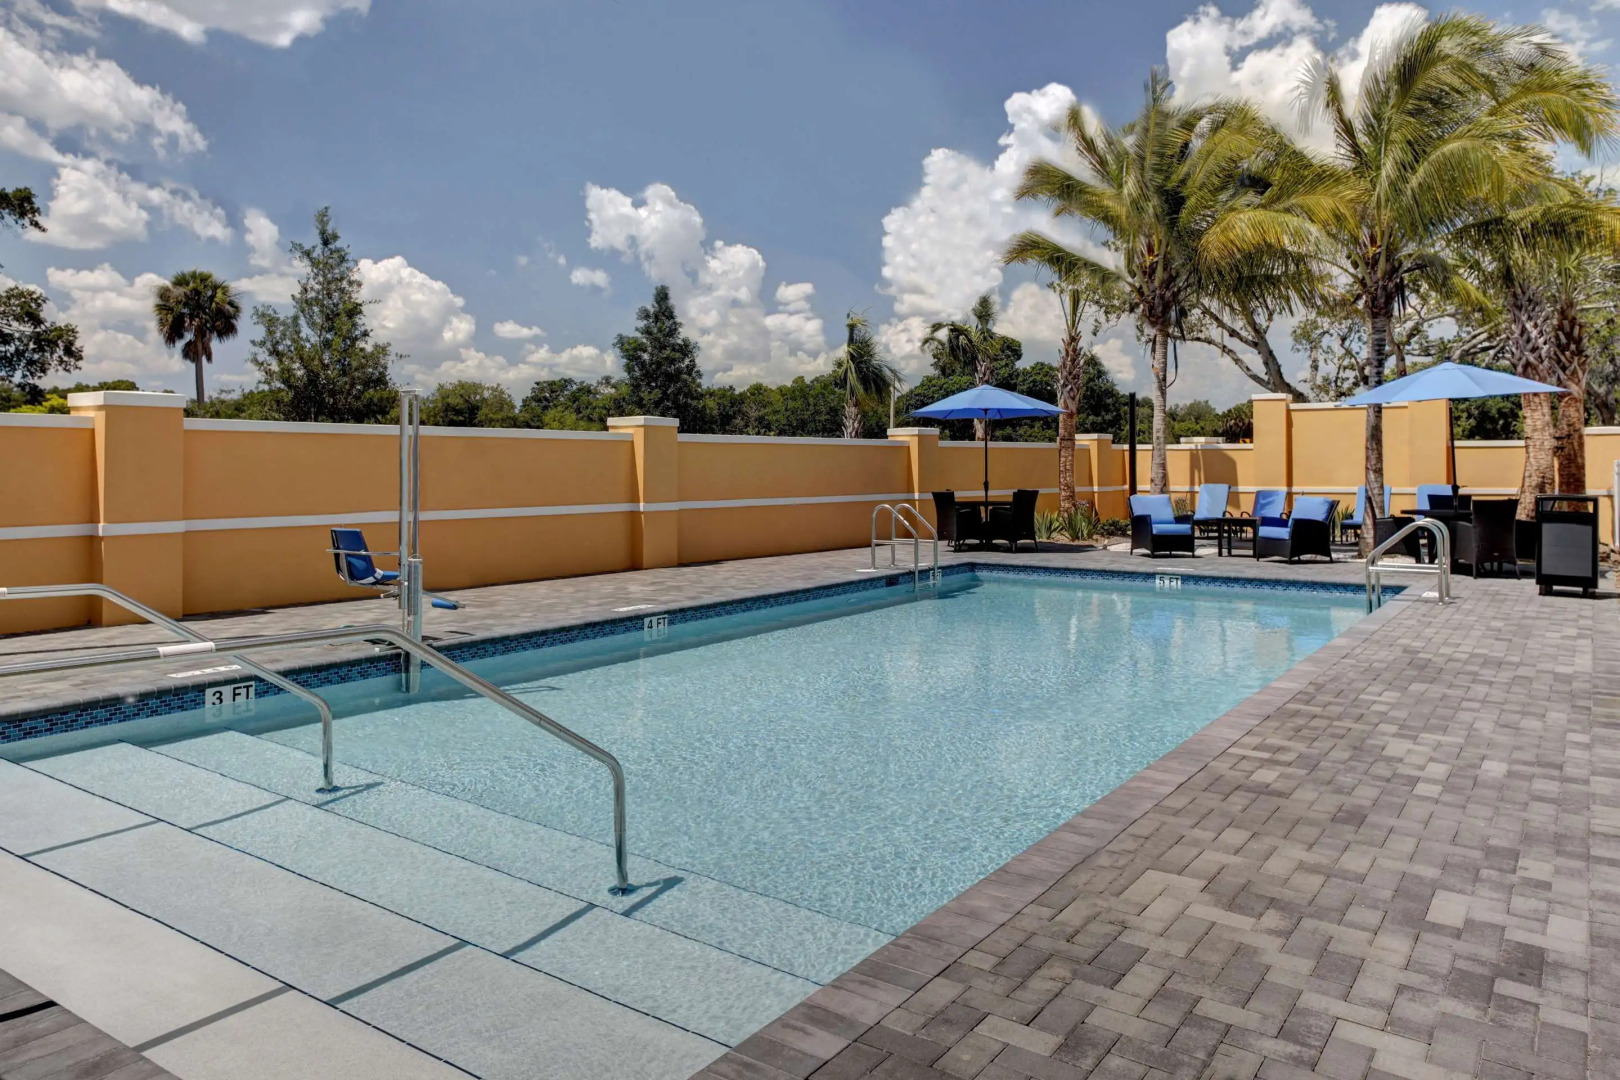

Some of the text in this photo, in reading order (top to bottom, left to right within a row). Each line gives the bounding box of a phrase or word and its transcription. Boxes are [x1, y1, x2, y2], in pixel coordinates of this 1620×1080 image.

[647, 617, 667, 629] 4 FT
[211, 690, 223, 705] 3
